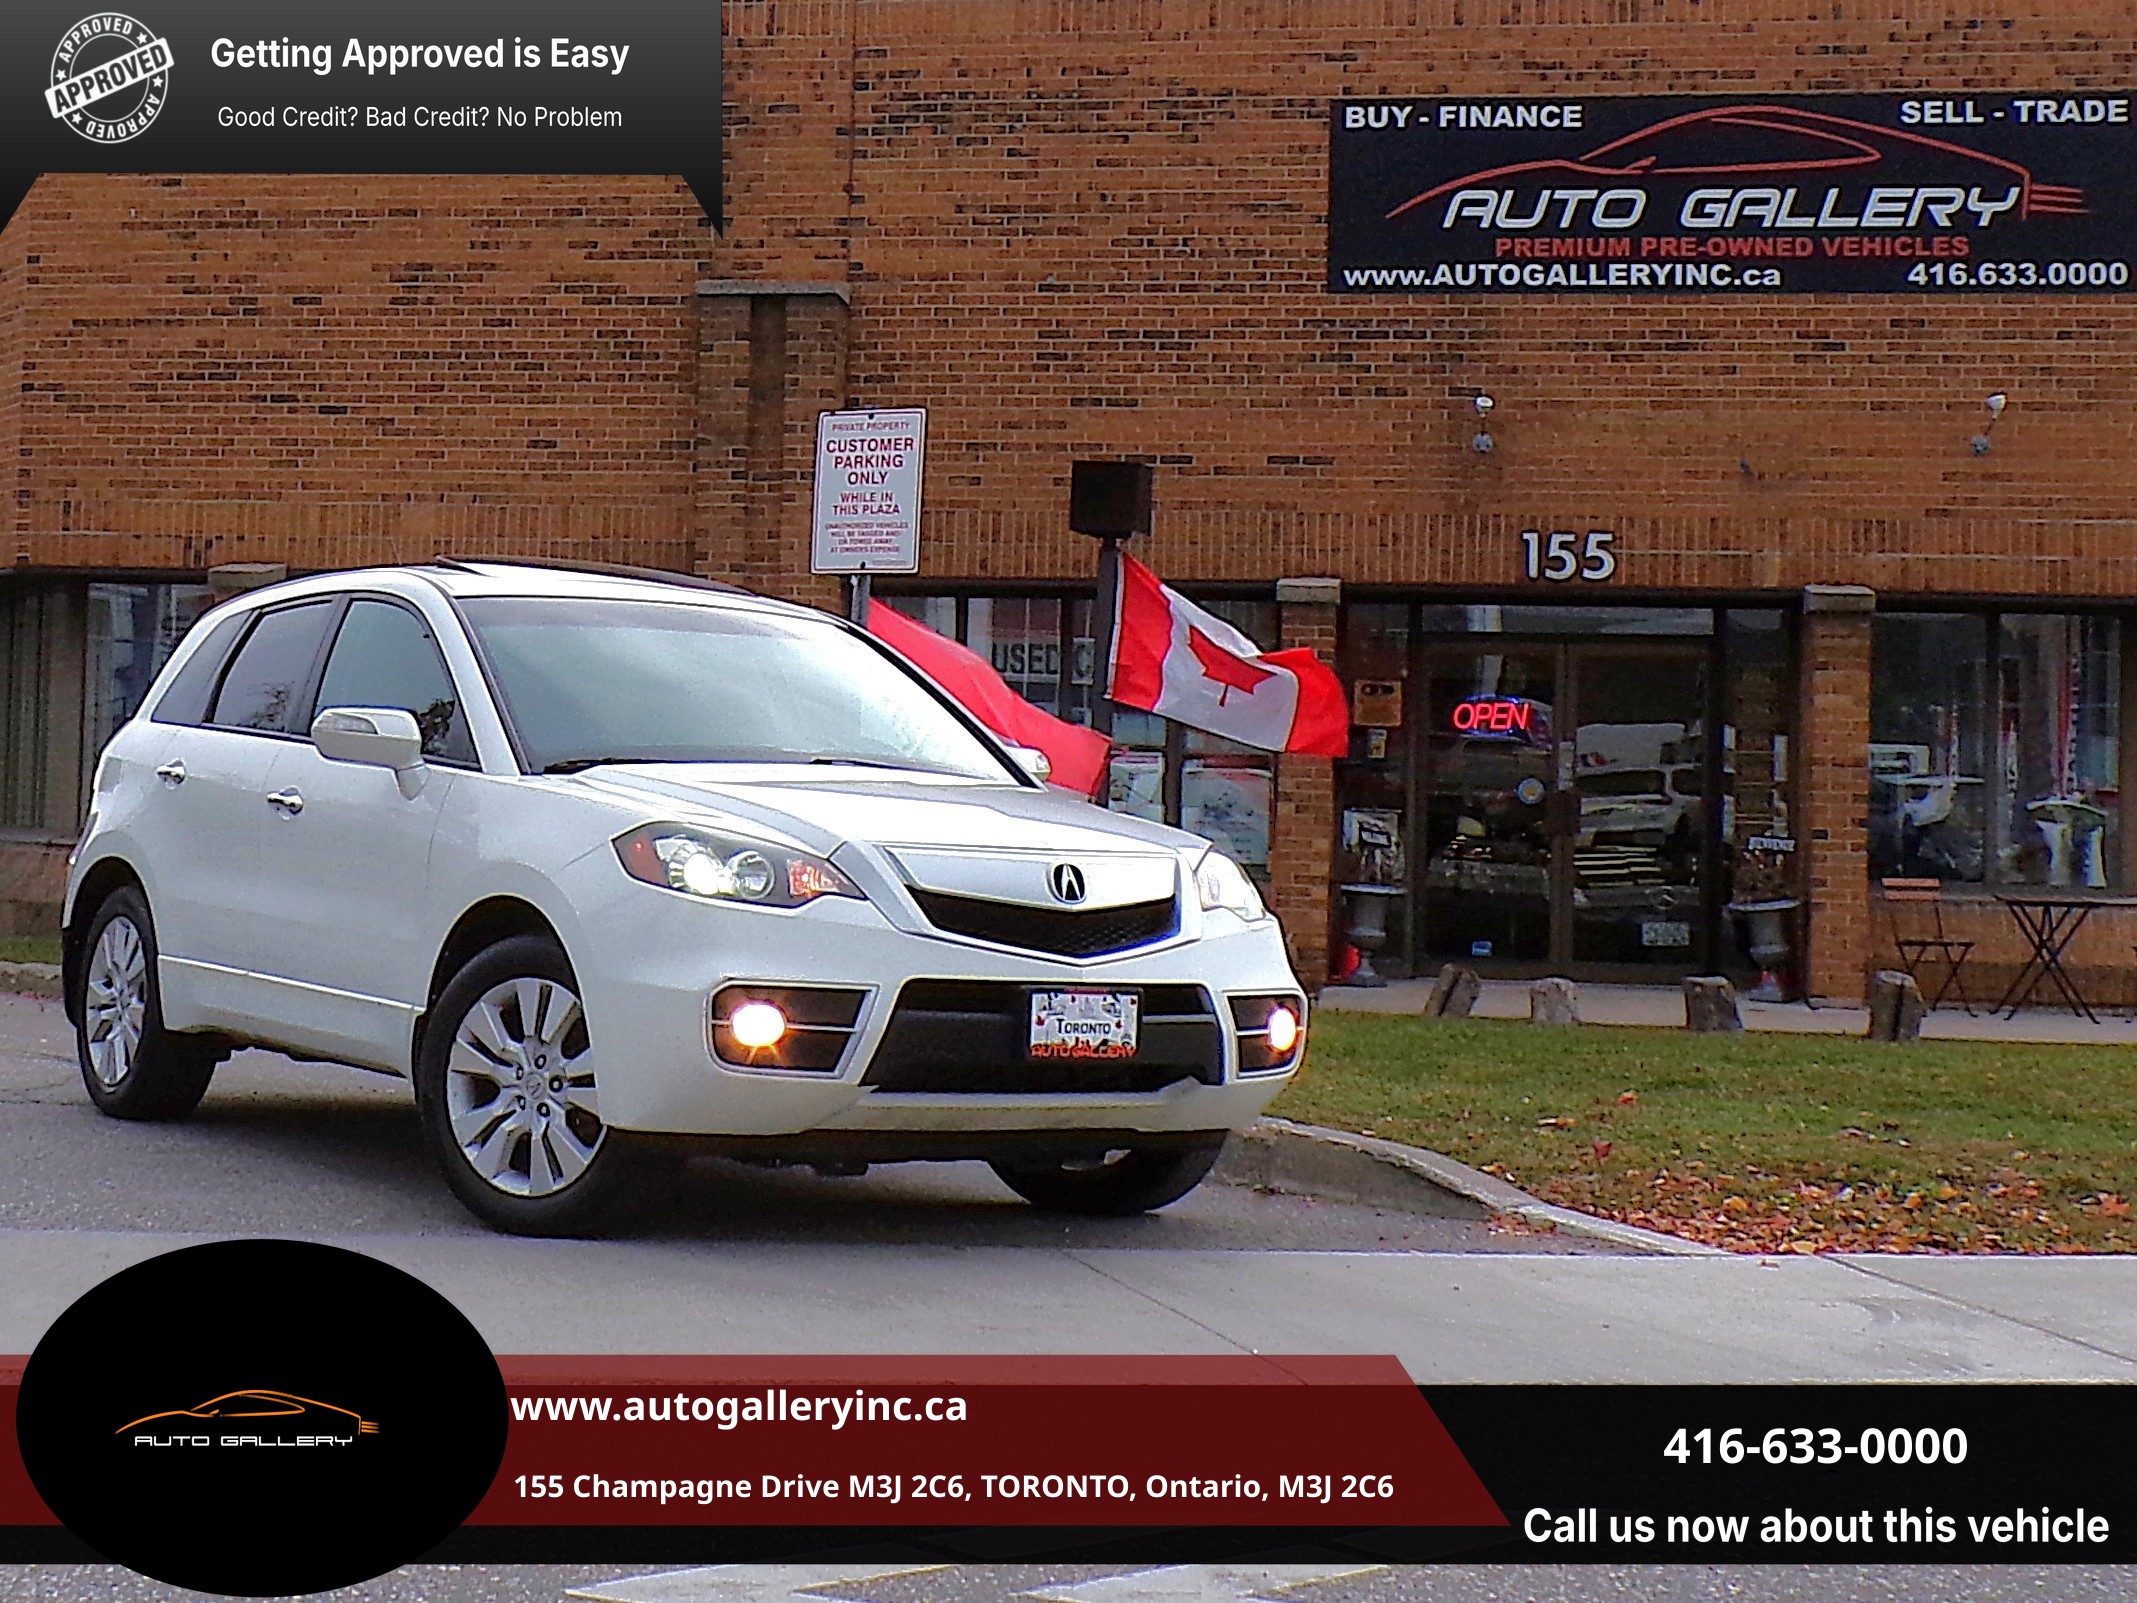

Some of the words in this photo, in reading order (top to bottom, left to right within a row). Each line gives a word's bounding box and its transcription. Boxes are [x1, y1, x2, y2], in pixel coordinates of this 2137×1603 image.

[1345, 106, 1413, 129] BUY
[1440, 105, 1583, 128] FINANCE
[1901, 100, 1985, 124] SELL
[2013, 99, 2129, 123] TRADE
[1442, 188, 1647, 229] AUTO
[1680, 187, 2021, 228] GALLERY
[1495, 238, 1630, 257] PREMIUM
[1641, 237, 1814, 257] PRE-OWNED
[1822, 236, 1970, 257] VEHICLES
[1343, 263, 1781, 287] www.AUTOGALLERYINC.ca
[1908, 262, 2129, 286] 416.633.0000
[832, 422, 865, 431] PRIVATE
[866, 421, 909, 430] PROPERTY
[827, 438, 914, 453] CUSTOMER
[834, 454, 904, 469] PARKING
[847, 471, 888, 485] ONLY
[840, 492, 877, 502] WHILE
[881, 492, 893, 501] IN
[832, 505, 859, 516] THIS
[861, 504, 901, 515] PLAZA
[1522, 532, 1616, 579] 155
[992, 643, 1059, 674] USED
[1453, 702, 1530, 730] OPEN
[1056, 1018, 1111, 1034] TORONTO
[1031, 1044, 1070, 1057] AUTO
